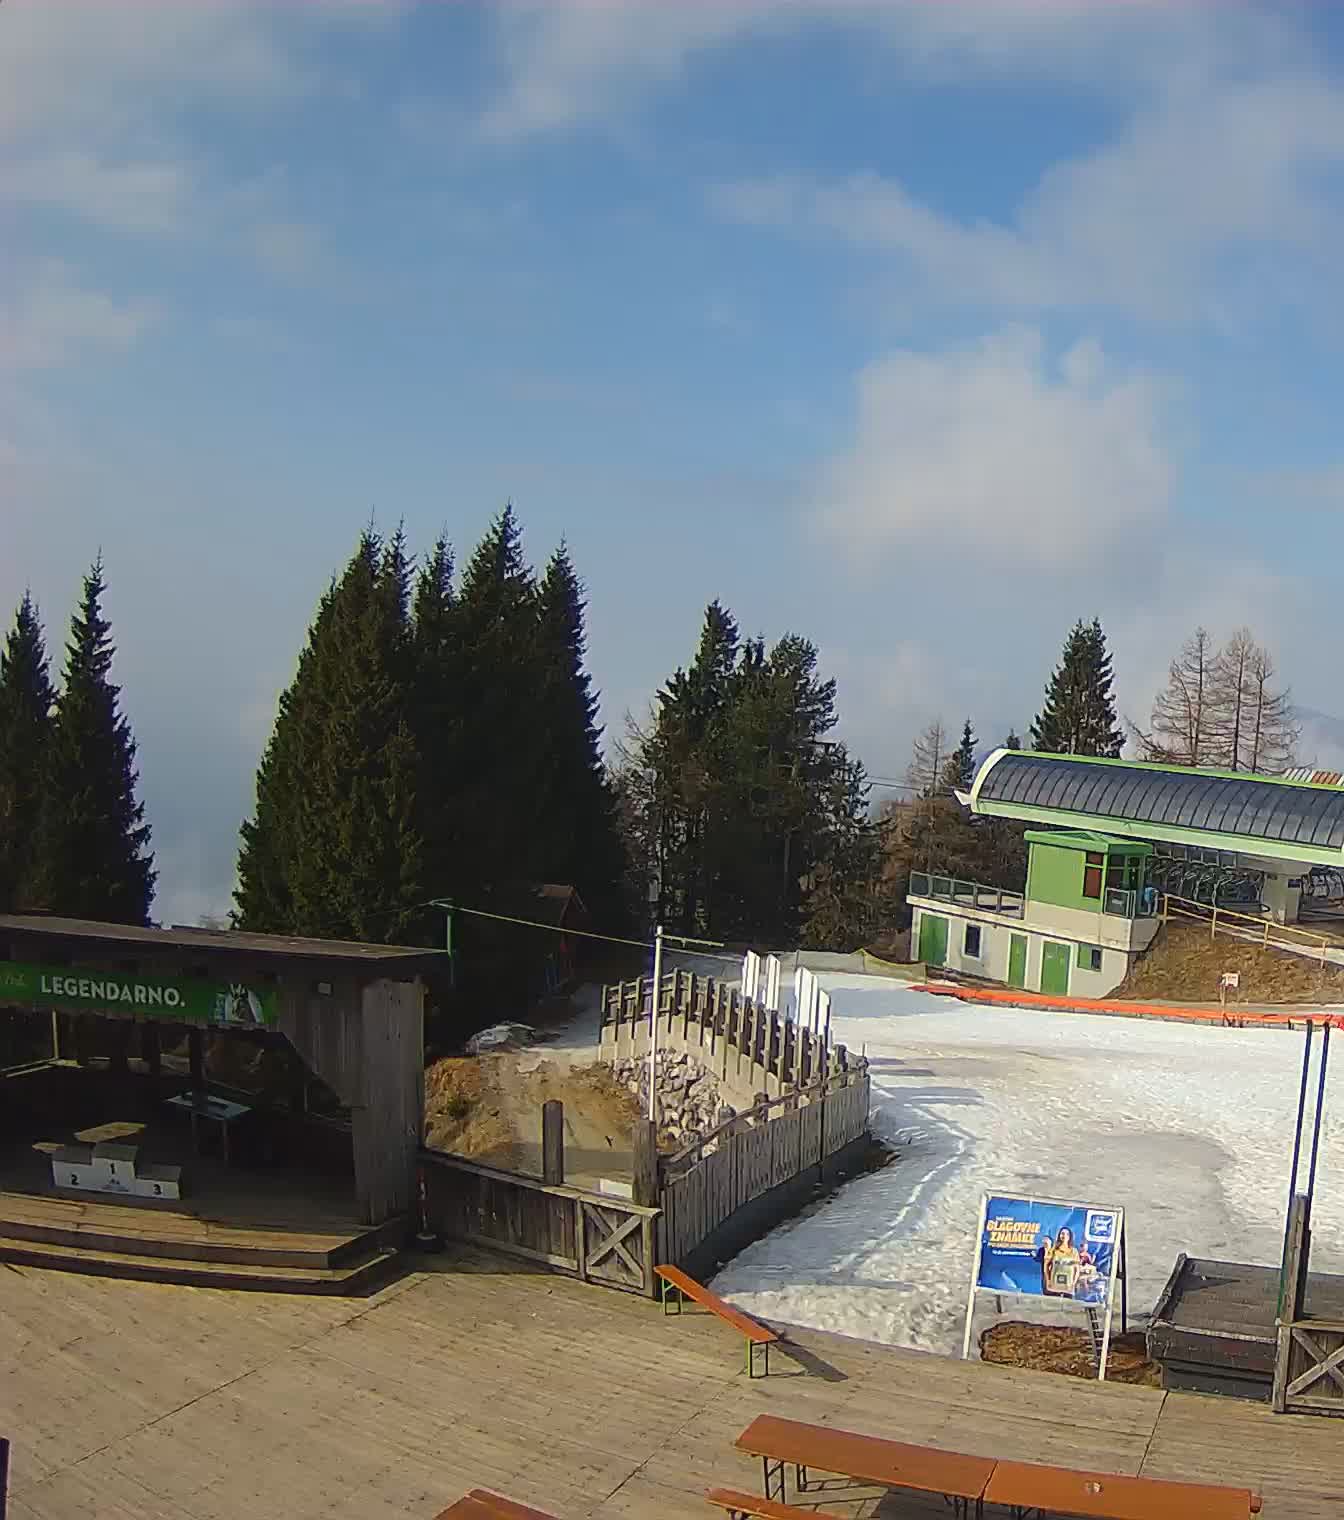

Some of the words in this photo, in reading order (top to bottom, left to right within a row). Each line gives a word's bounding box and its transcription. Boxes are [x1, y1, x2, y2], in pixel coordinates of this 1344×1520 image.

[41, 975, 186, 1007] LEGENDARNO.
[110, 1162, 116, 1175] 1
[71, 1174, 79, 1185] 2
[153, 1183, 162, 1195] 3
